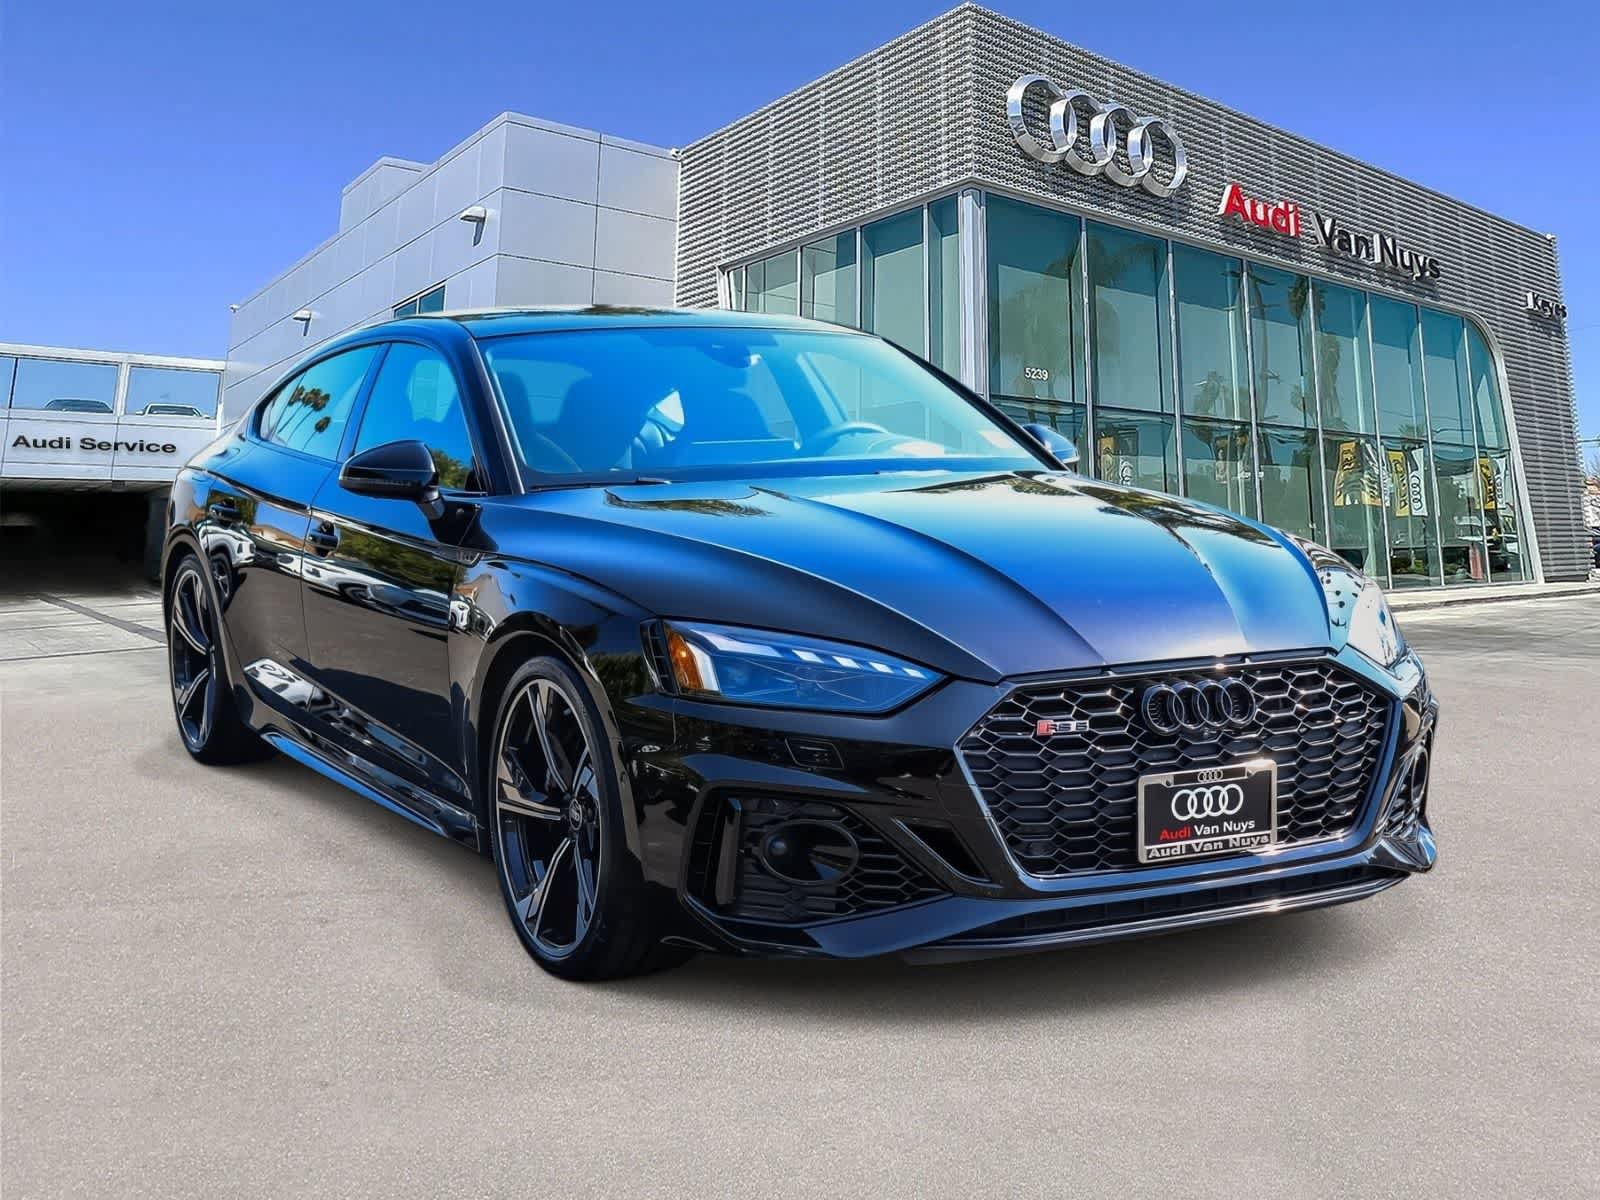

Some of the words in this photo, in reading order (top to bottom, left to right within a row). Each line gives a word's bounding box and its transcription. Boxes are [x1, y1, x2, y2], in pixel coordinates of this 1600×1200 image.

[1217, 183, 1301, 237] Audi
[1312, 212, 1369, 259] Van
[1373, 233, 1441, 281] Nuys
[1024, 367, 1049, 381] 5239
[12, 435, 71, 449] Audi
[79, 437, 177, 454] Service
[1159, 826, 1191, 841] Audi
[1194, 824, 1219, 836] Van
[1223, 819, 1256, 834] Nuys
[1148, 844, 1186, 859] Audi
[1191, 840, 1223, 852] Van
[1229, 834, 1269, 849] Nuys
